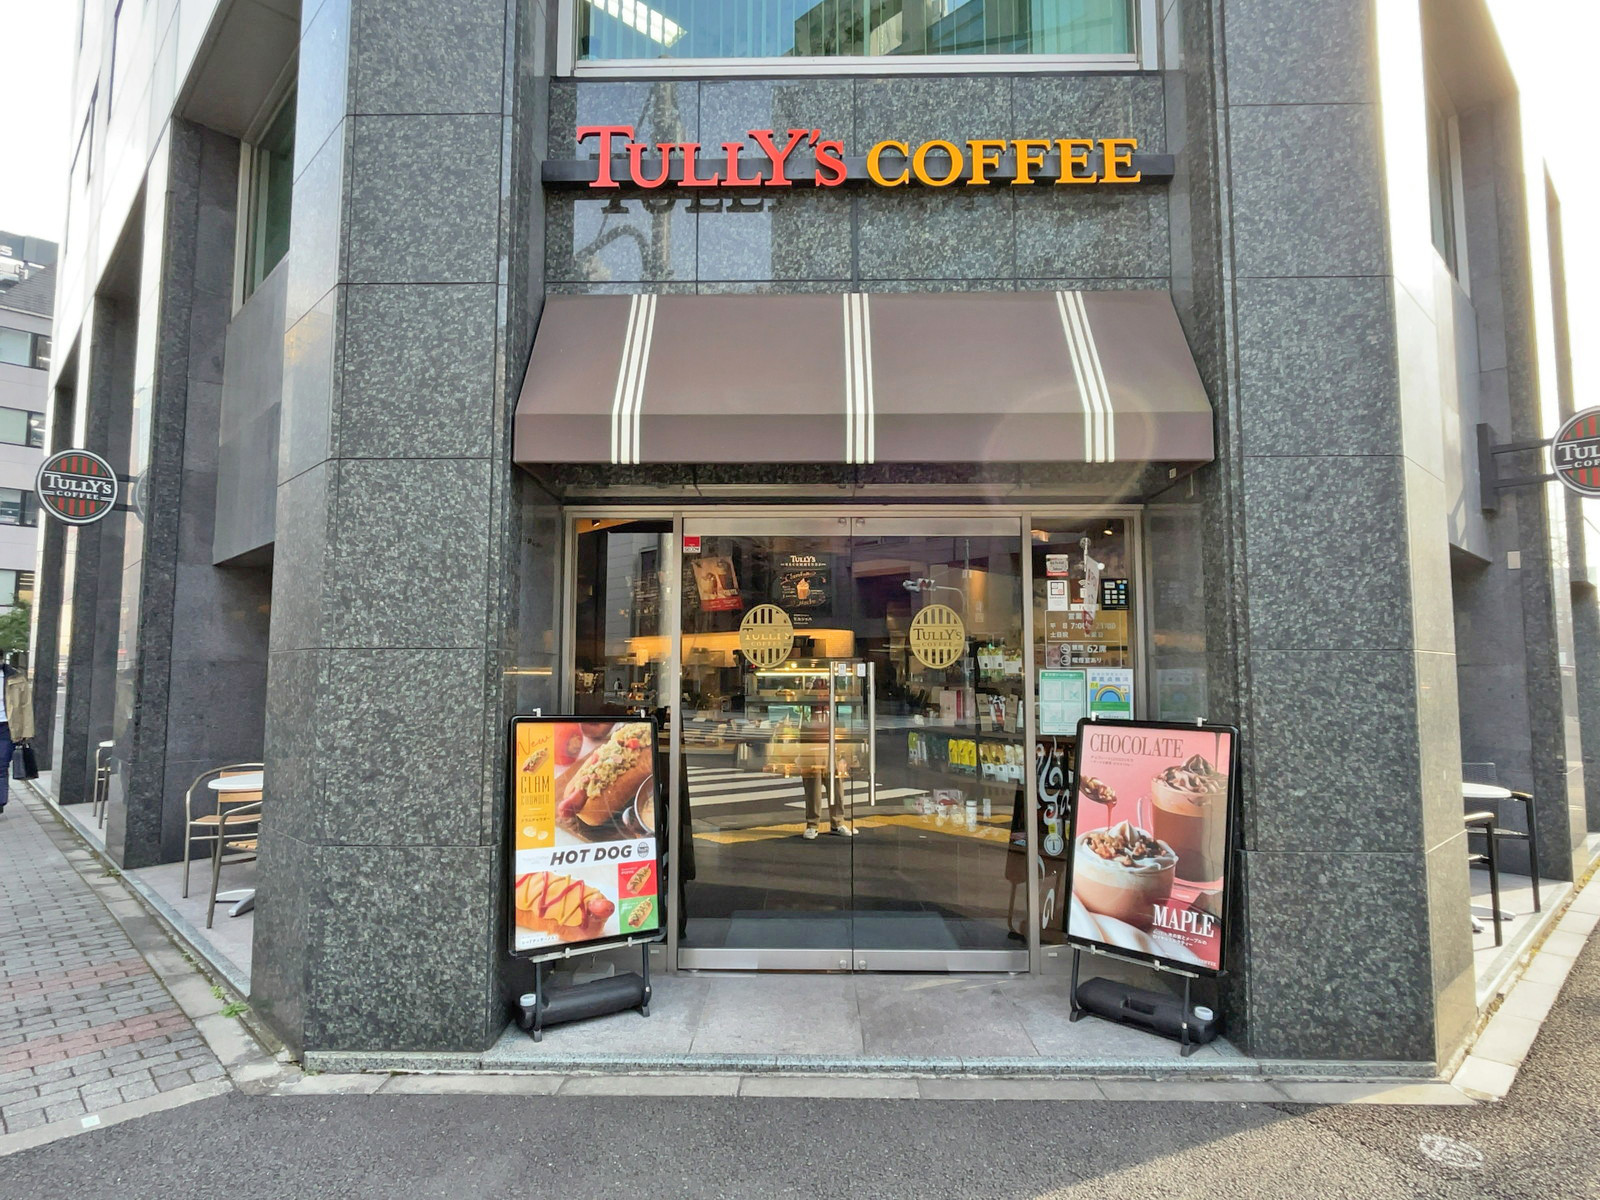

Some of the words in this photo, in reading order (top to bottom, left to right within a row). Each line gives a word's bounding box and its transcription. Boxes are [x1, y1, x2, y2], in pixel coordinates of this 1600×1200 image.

[576, 125, 848, 189] TULLY'S
[866, 138, 1142, 188] COFFEE
[45, 473, 112, 495] TULLY'S
[56, 490, 99, 500] COFFEE
[913, 627, 963, 641] TULLY'S
[517, 728, 552, 756] New
[1090, 733, 1184, 759] CHOCOLATE
[520, 775, 550, 794] CLAM
[550, 849, 591, 866] HOT
[594, 845, 632, 862] DOG
[1152, 904, 1215, 938] MAPLE
